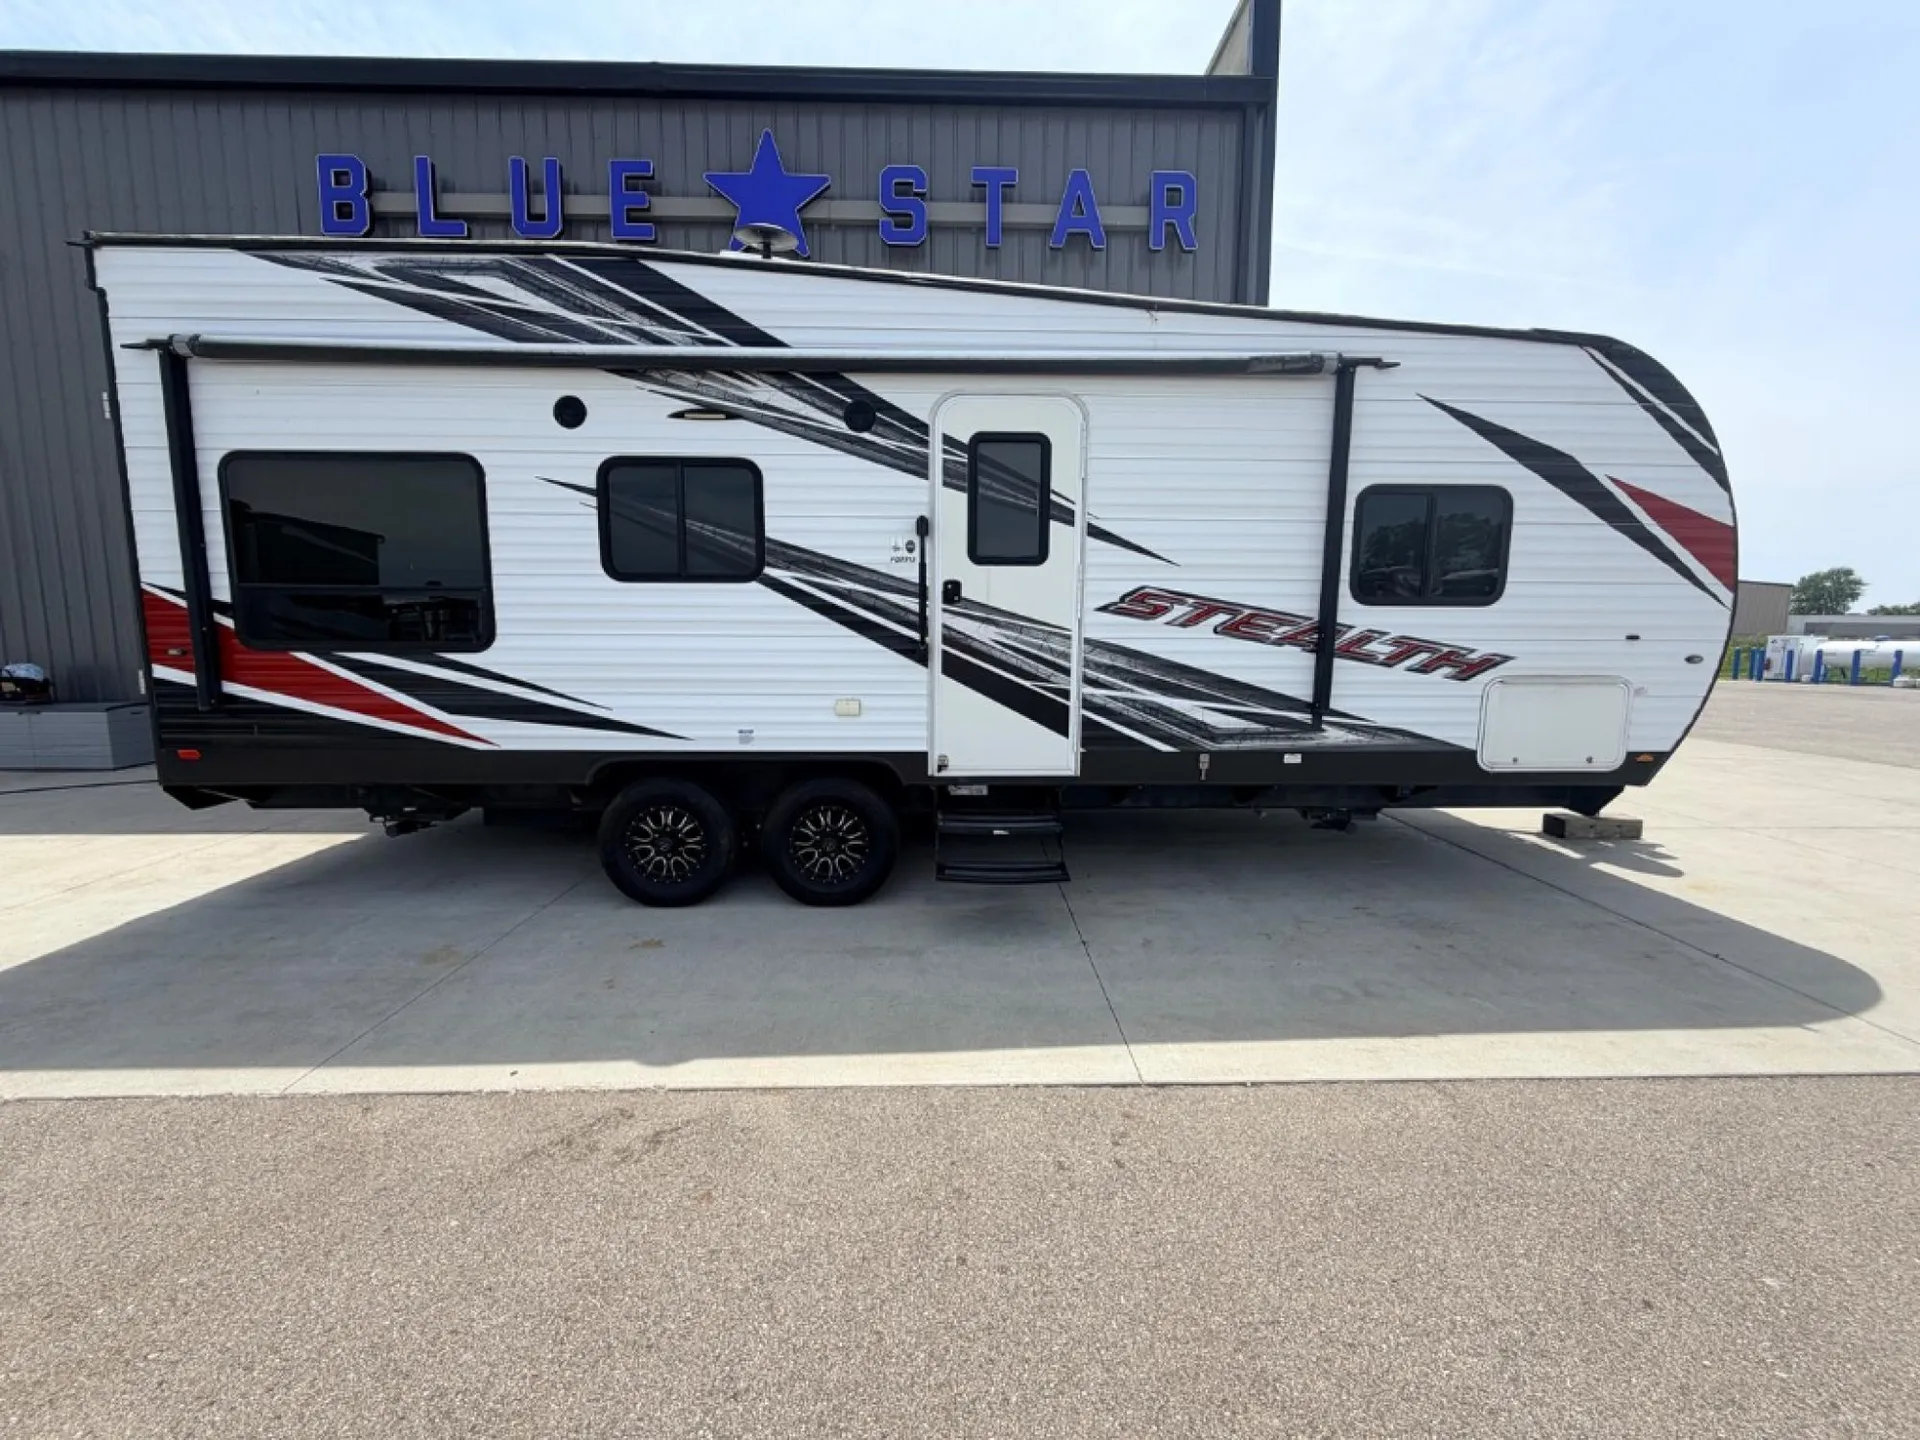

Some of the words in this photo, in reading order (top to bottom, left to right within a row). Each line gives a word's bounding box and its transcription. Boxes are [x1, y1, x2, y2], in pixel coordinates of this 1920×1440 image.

[316, 153, 656, 241] BLUE
[878, 164, 1199, 251] STAR
[1096, 585, 1514, 681] STEALTH
